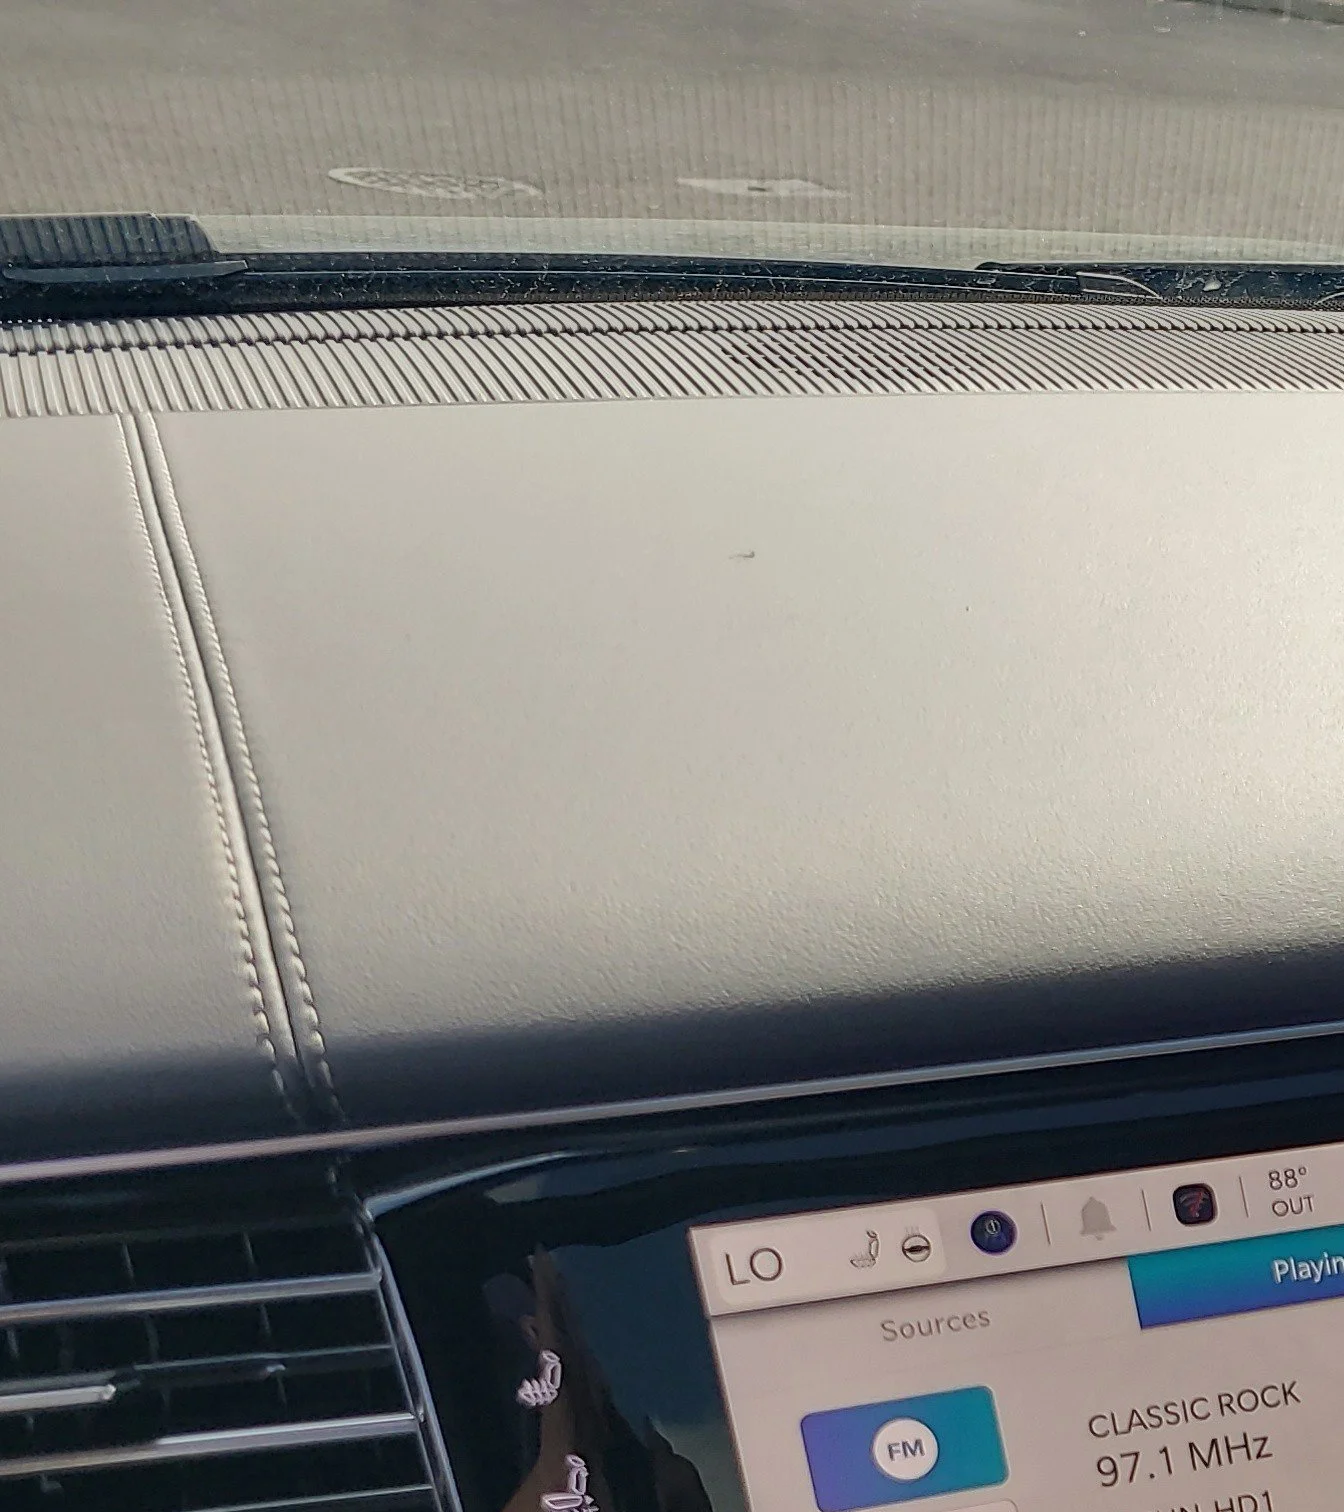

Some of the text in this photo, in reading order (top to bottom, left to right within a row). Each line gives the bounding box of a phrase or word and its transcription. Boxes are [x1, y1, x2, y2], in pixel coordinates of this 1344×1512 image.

[1270, 1194, 1315, 1218] OUT
[724, 1246, 784, 1288] LO
[880, 1306, 991, 1343] Sources
[1087, 1380, 1302, 1441] CLASSIC ROCK
[886, 1435, 925, 1462] FM
[1095, 1431, 1274, 1489] 97.1 MHz
